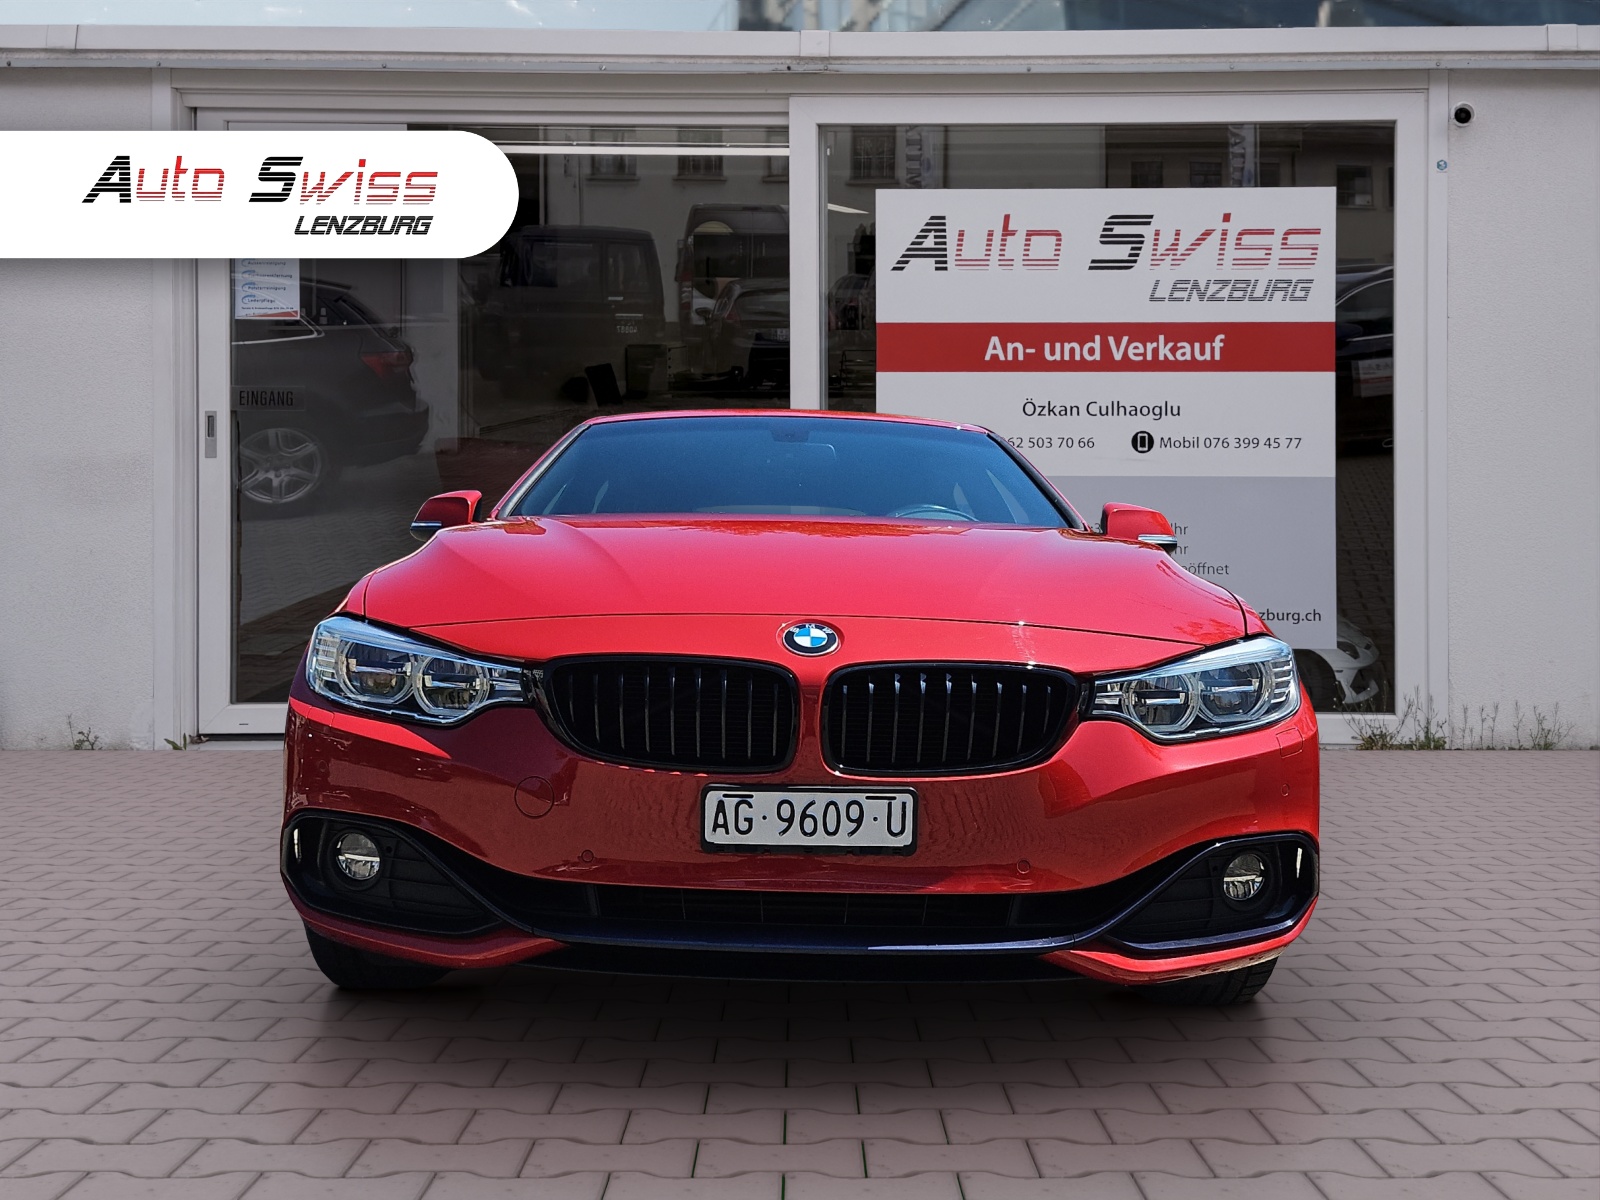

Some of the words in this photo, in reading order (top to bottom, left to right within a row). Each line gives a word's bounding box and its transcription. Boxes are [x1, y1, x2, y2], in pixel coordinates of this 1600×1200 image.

[890, 214, 1063, 271] Auto
[1087, 212, 1322, 271] Swiss
[1149, 278, 1315, 302] LENZBURG
[985, 336, 1035, 361] An-
[1043, 335, 1101, 361] und
[1107, 334, 1225, 362] Verkauf
[239, 390, 294, 406] EINGANG
[1022, 398, 1080, 417] Özkan
[1085, 400, 1181, 420] Culhaoglu
[1007, 437, 1023, 449] 62
[1028, 437, 1053, 449] 503
[1057, 437, 1074, 449] 70
[1078, 437, 1095, 449] 66
[1159, 436, 1200, 449] Mobil
[1203, 437, 1230, 449] 076
[1233, 437, 1260, 449] 399
[1263, 437, 1281, 449] 45
[1284, 437, 1302, 449] 77
[1172, 543, 1188, 555] hr
[1181, 562, 1229, 575] eöffnet
[1259, 608, 1322, 625] zburg.ch
